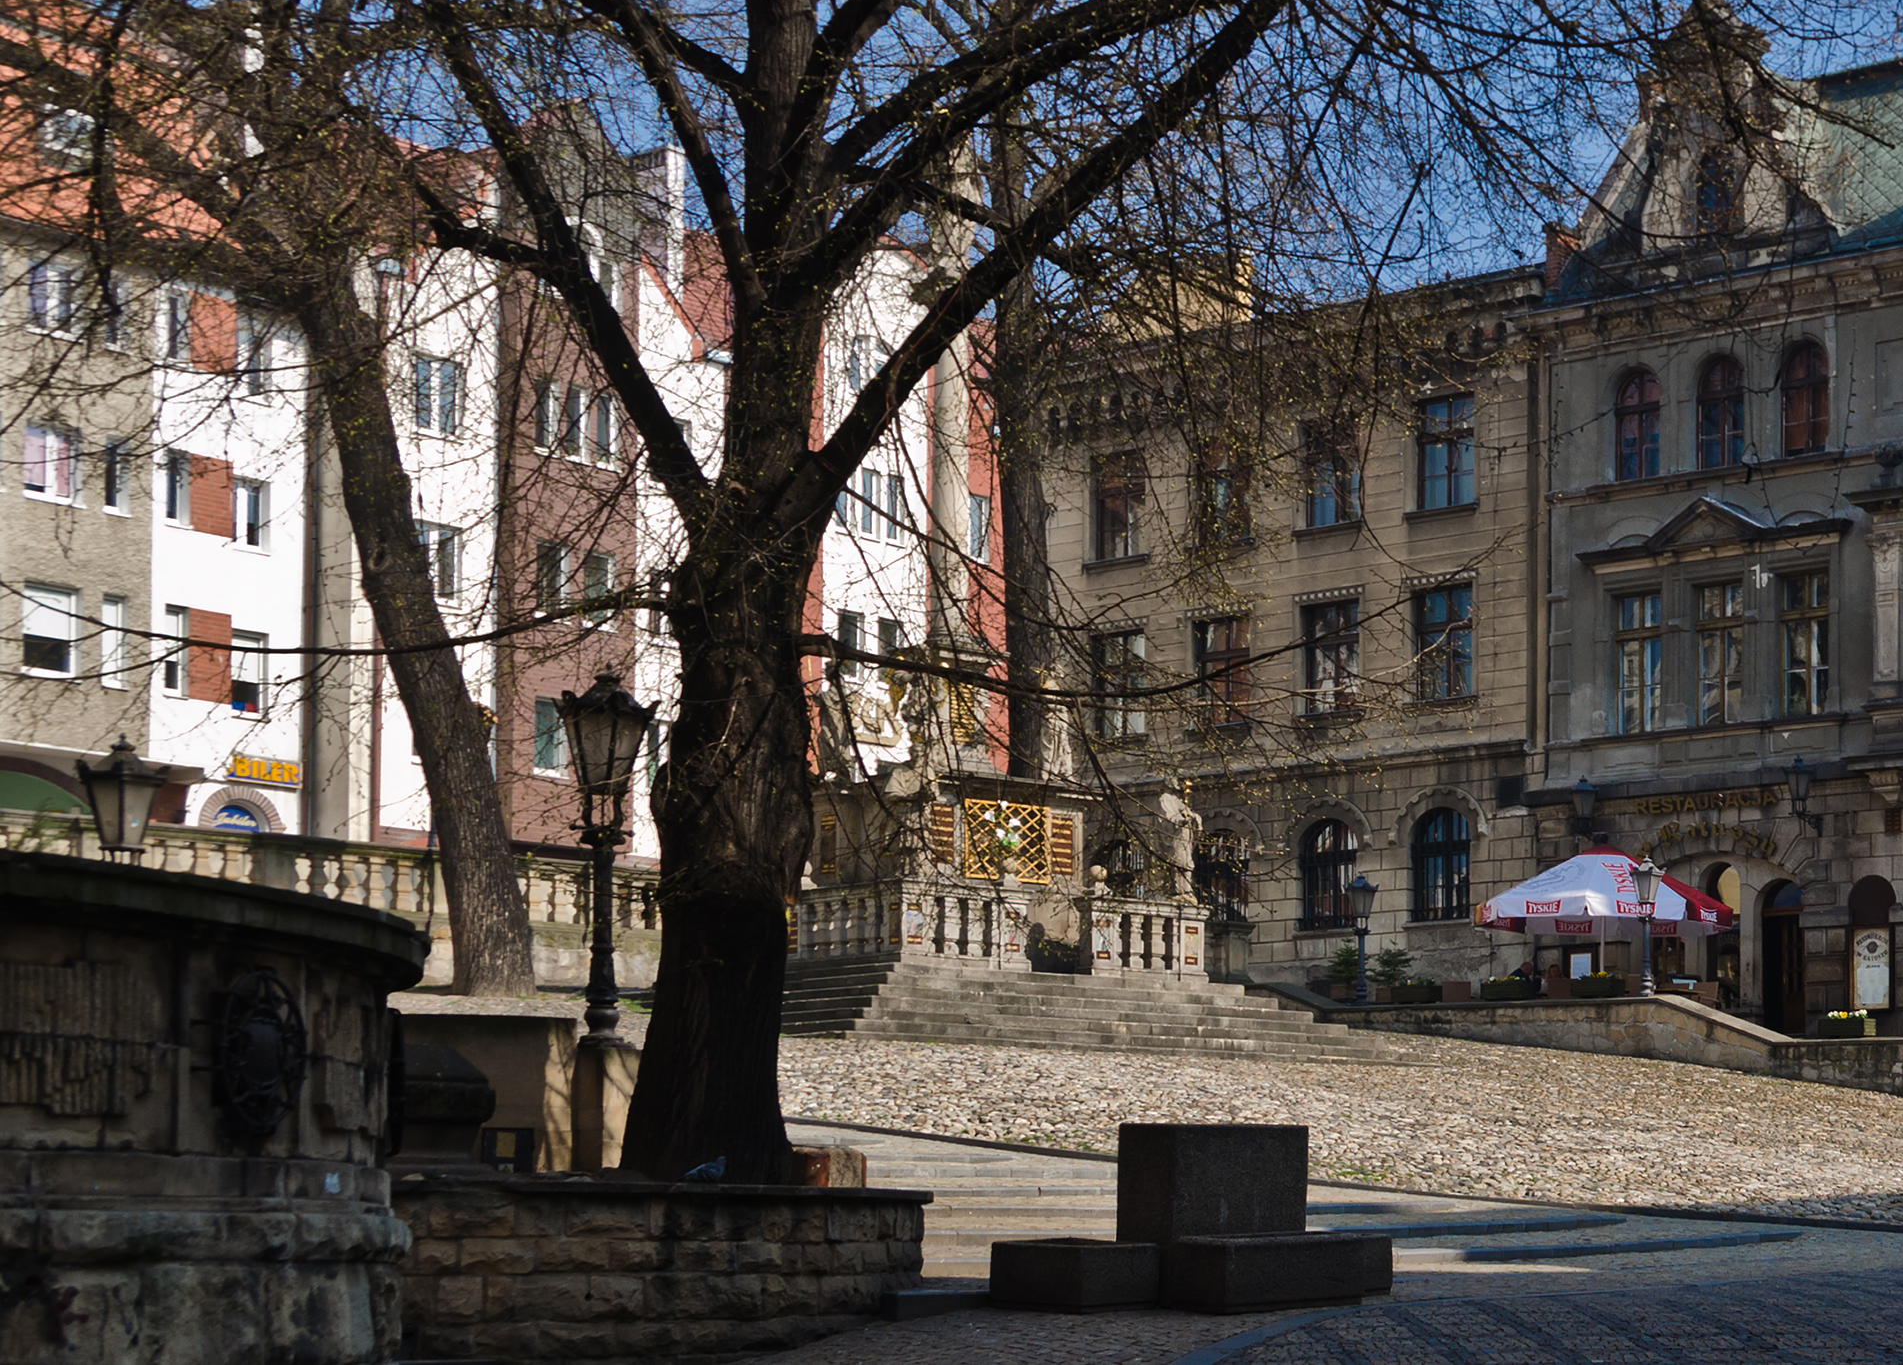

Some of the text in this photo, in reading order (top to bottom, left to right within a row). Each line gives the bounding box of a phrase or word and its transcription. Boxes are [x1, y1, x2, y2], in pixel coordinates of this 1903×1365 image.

[1635, 790, 1777, 815] RESTAURACJA
[1601, 862, 1638, 894] TYSKIE
[1528, 902, 1559, 914] TYSKIE
